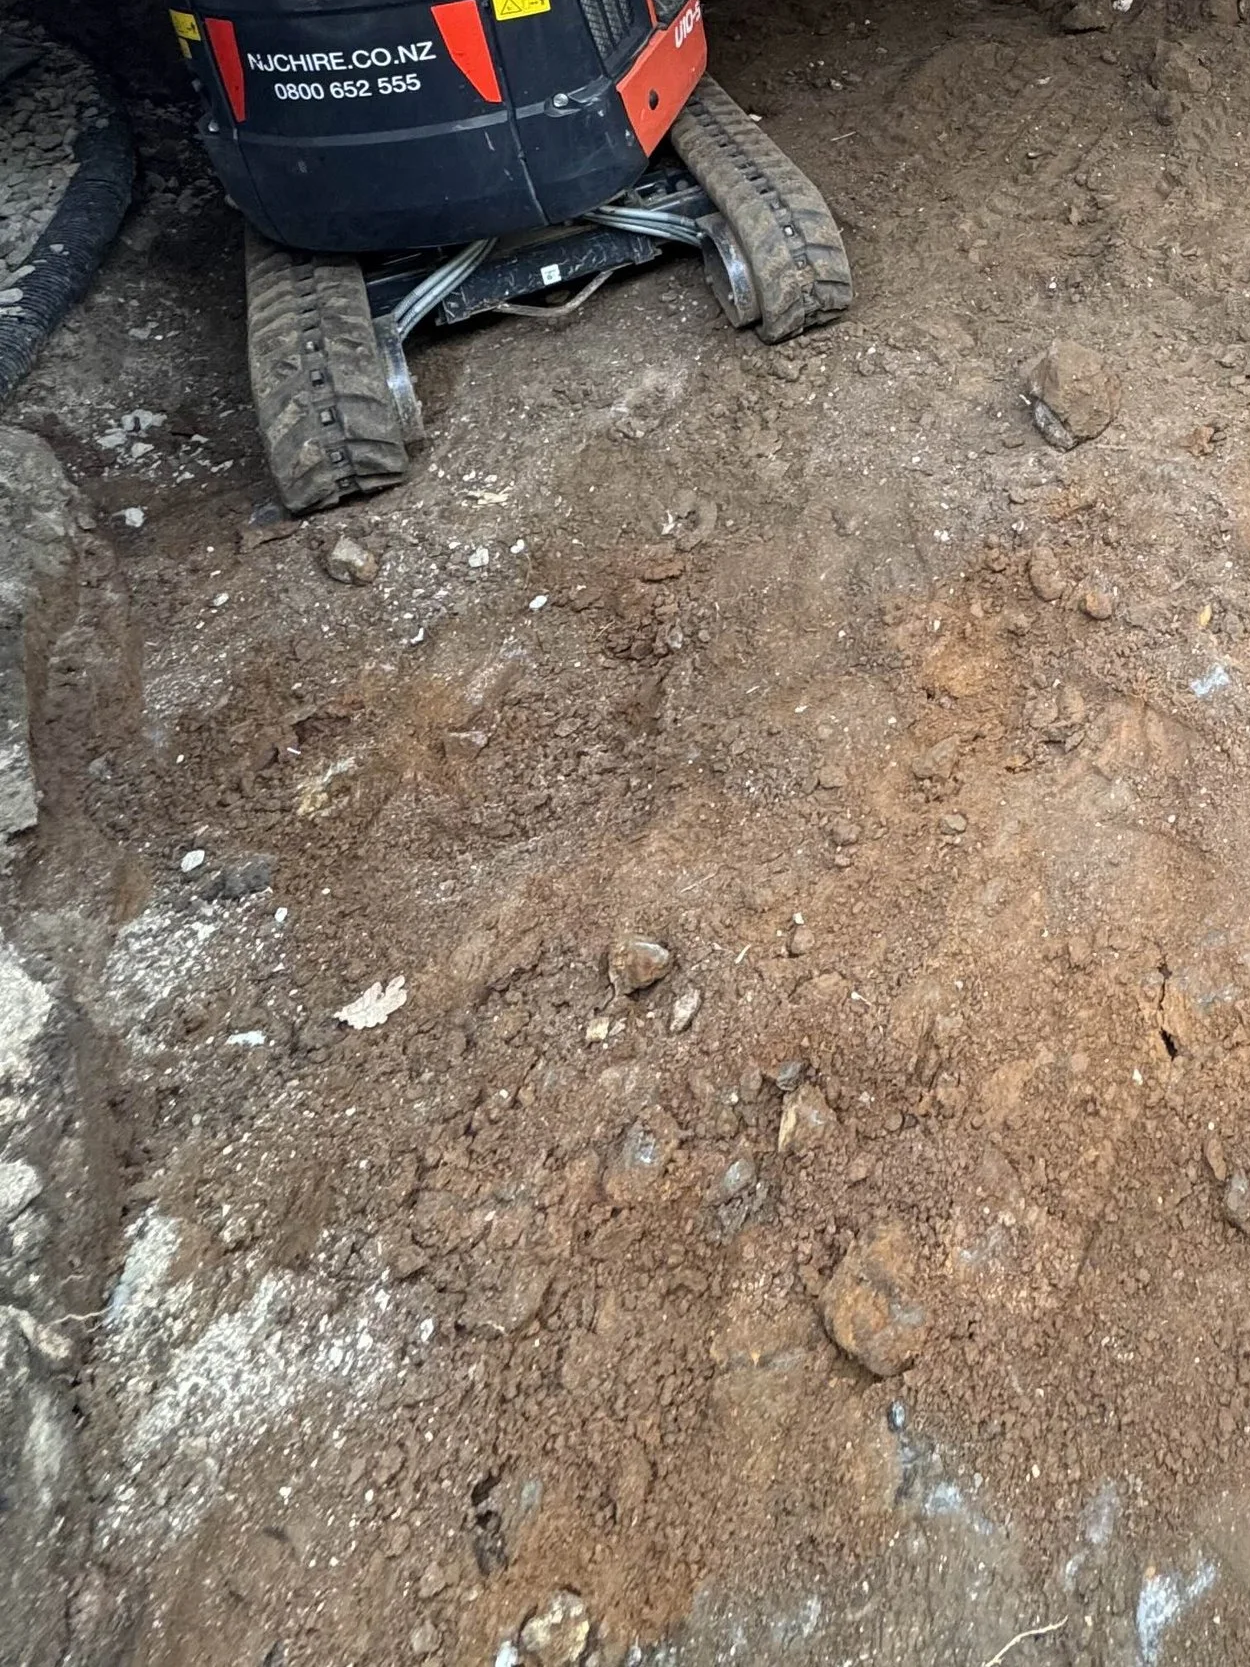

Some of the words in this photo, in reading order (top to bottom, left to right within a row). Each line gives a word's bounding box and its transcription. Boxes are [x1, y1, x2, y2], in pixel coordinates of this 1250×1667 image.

[247, 40, 437, 73] NJCHIRE.CO.NZ
[274, 83, 325, 101] 0800
[329, 79, 372, 99] 652
[377, 73, 422, 95] 555
